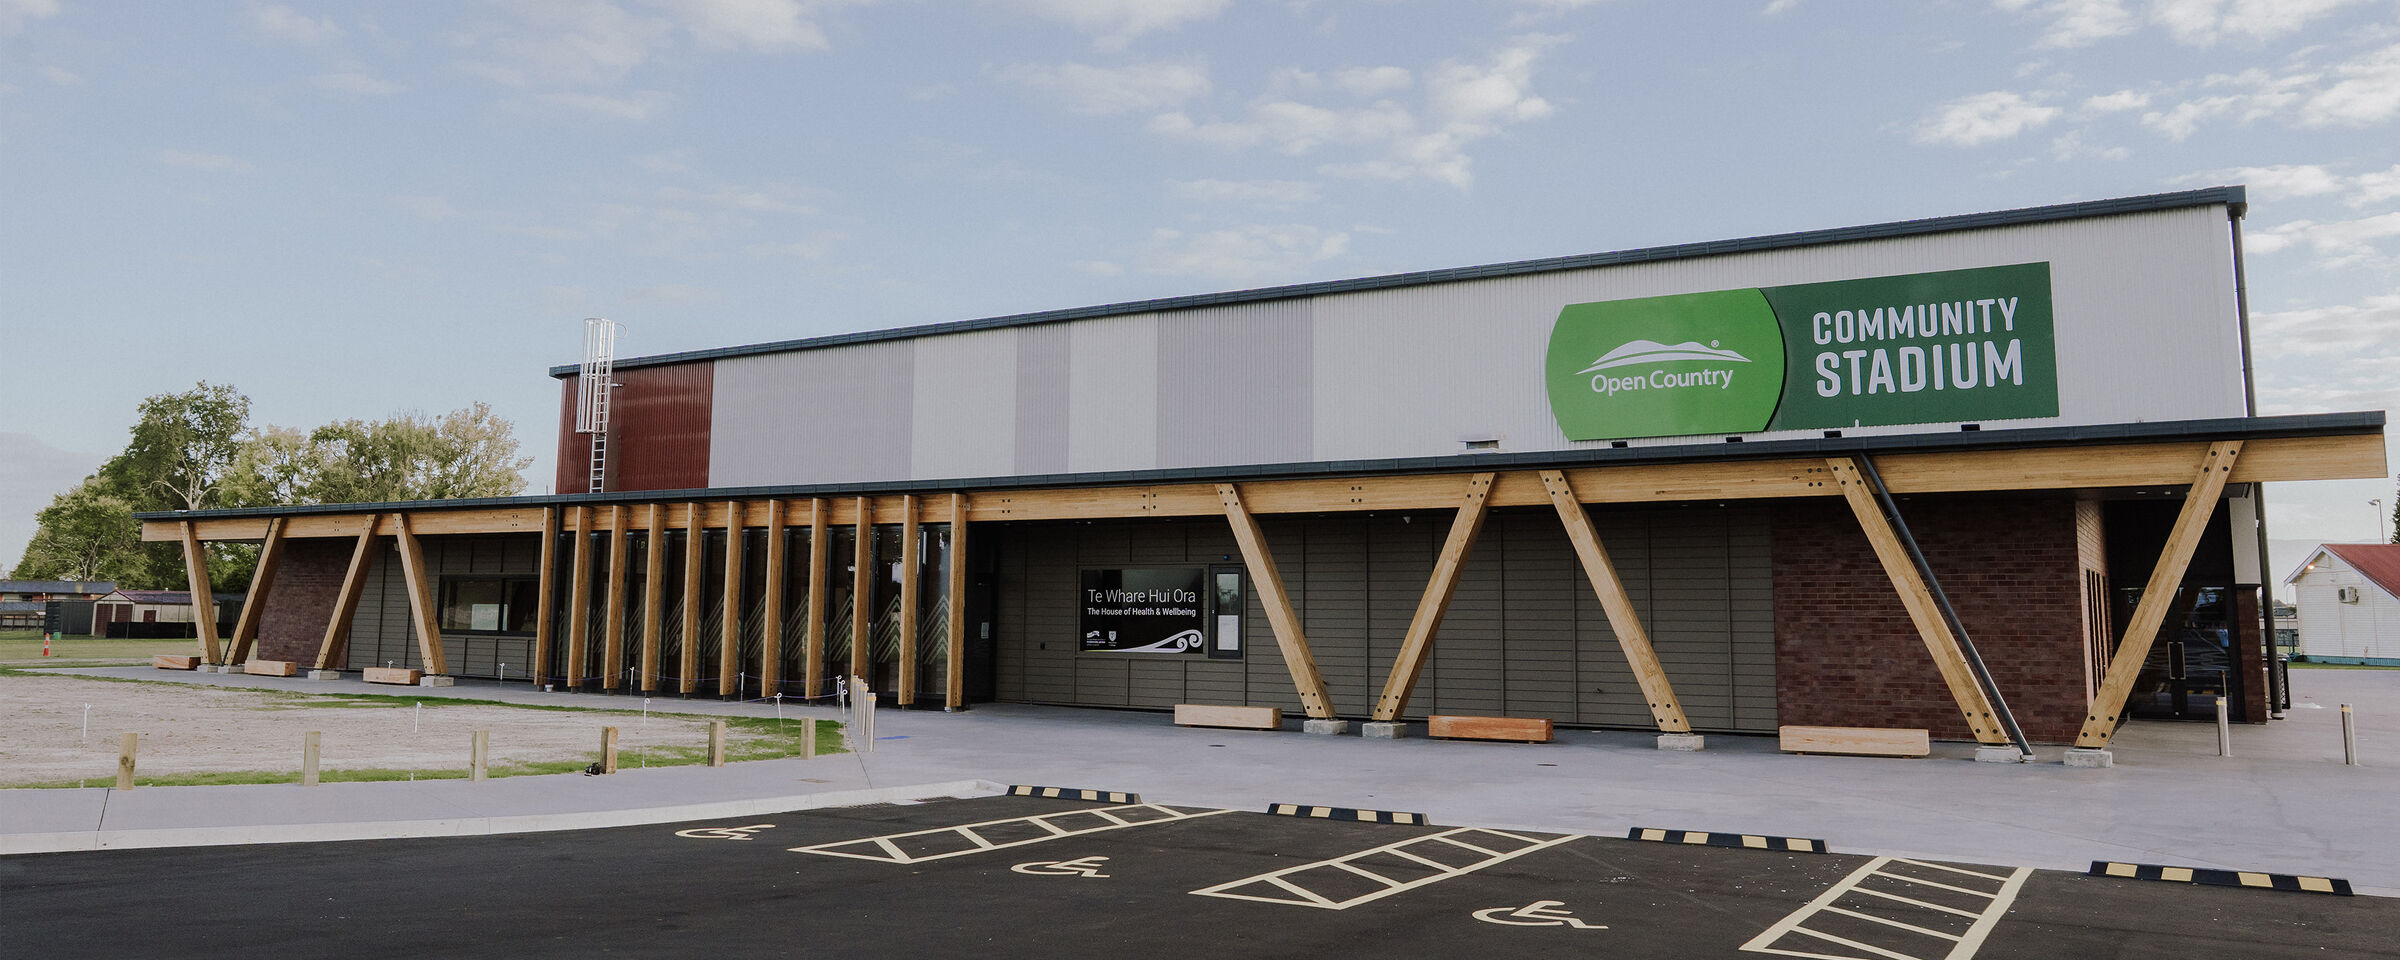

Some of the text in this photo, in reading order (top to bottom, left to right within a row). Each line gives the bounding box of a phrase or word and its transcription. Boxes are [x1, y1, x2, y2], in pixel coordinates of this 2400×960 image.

[1812, 297, 2019, 345] COMMUNITY
[1591, 368, 1734, 397] Open Country
[1815, 338, 2024, 398] STADIUM
[1087, 588, 1196, 603] Te Whare Hui Ora
[1087, 607, 1197, 618] The House of Health & Wellbeing
